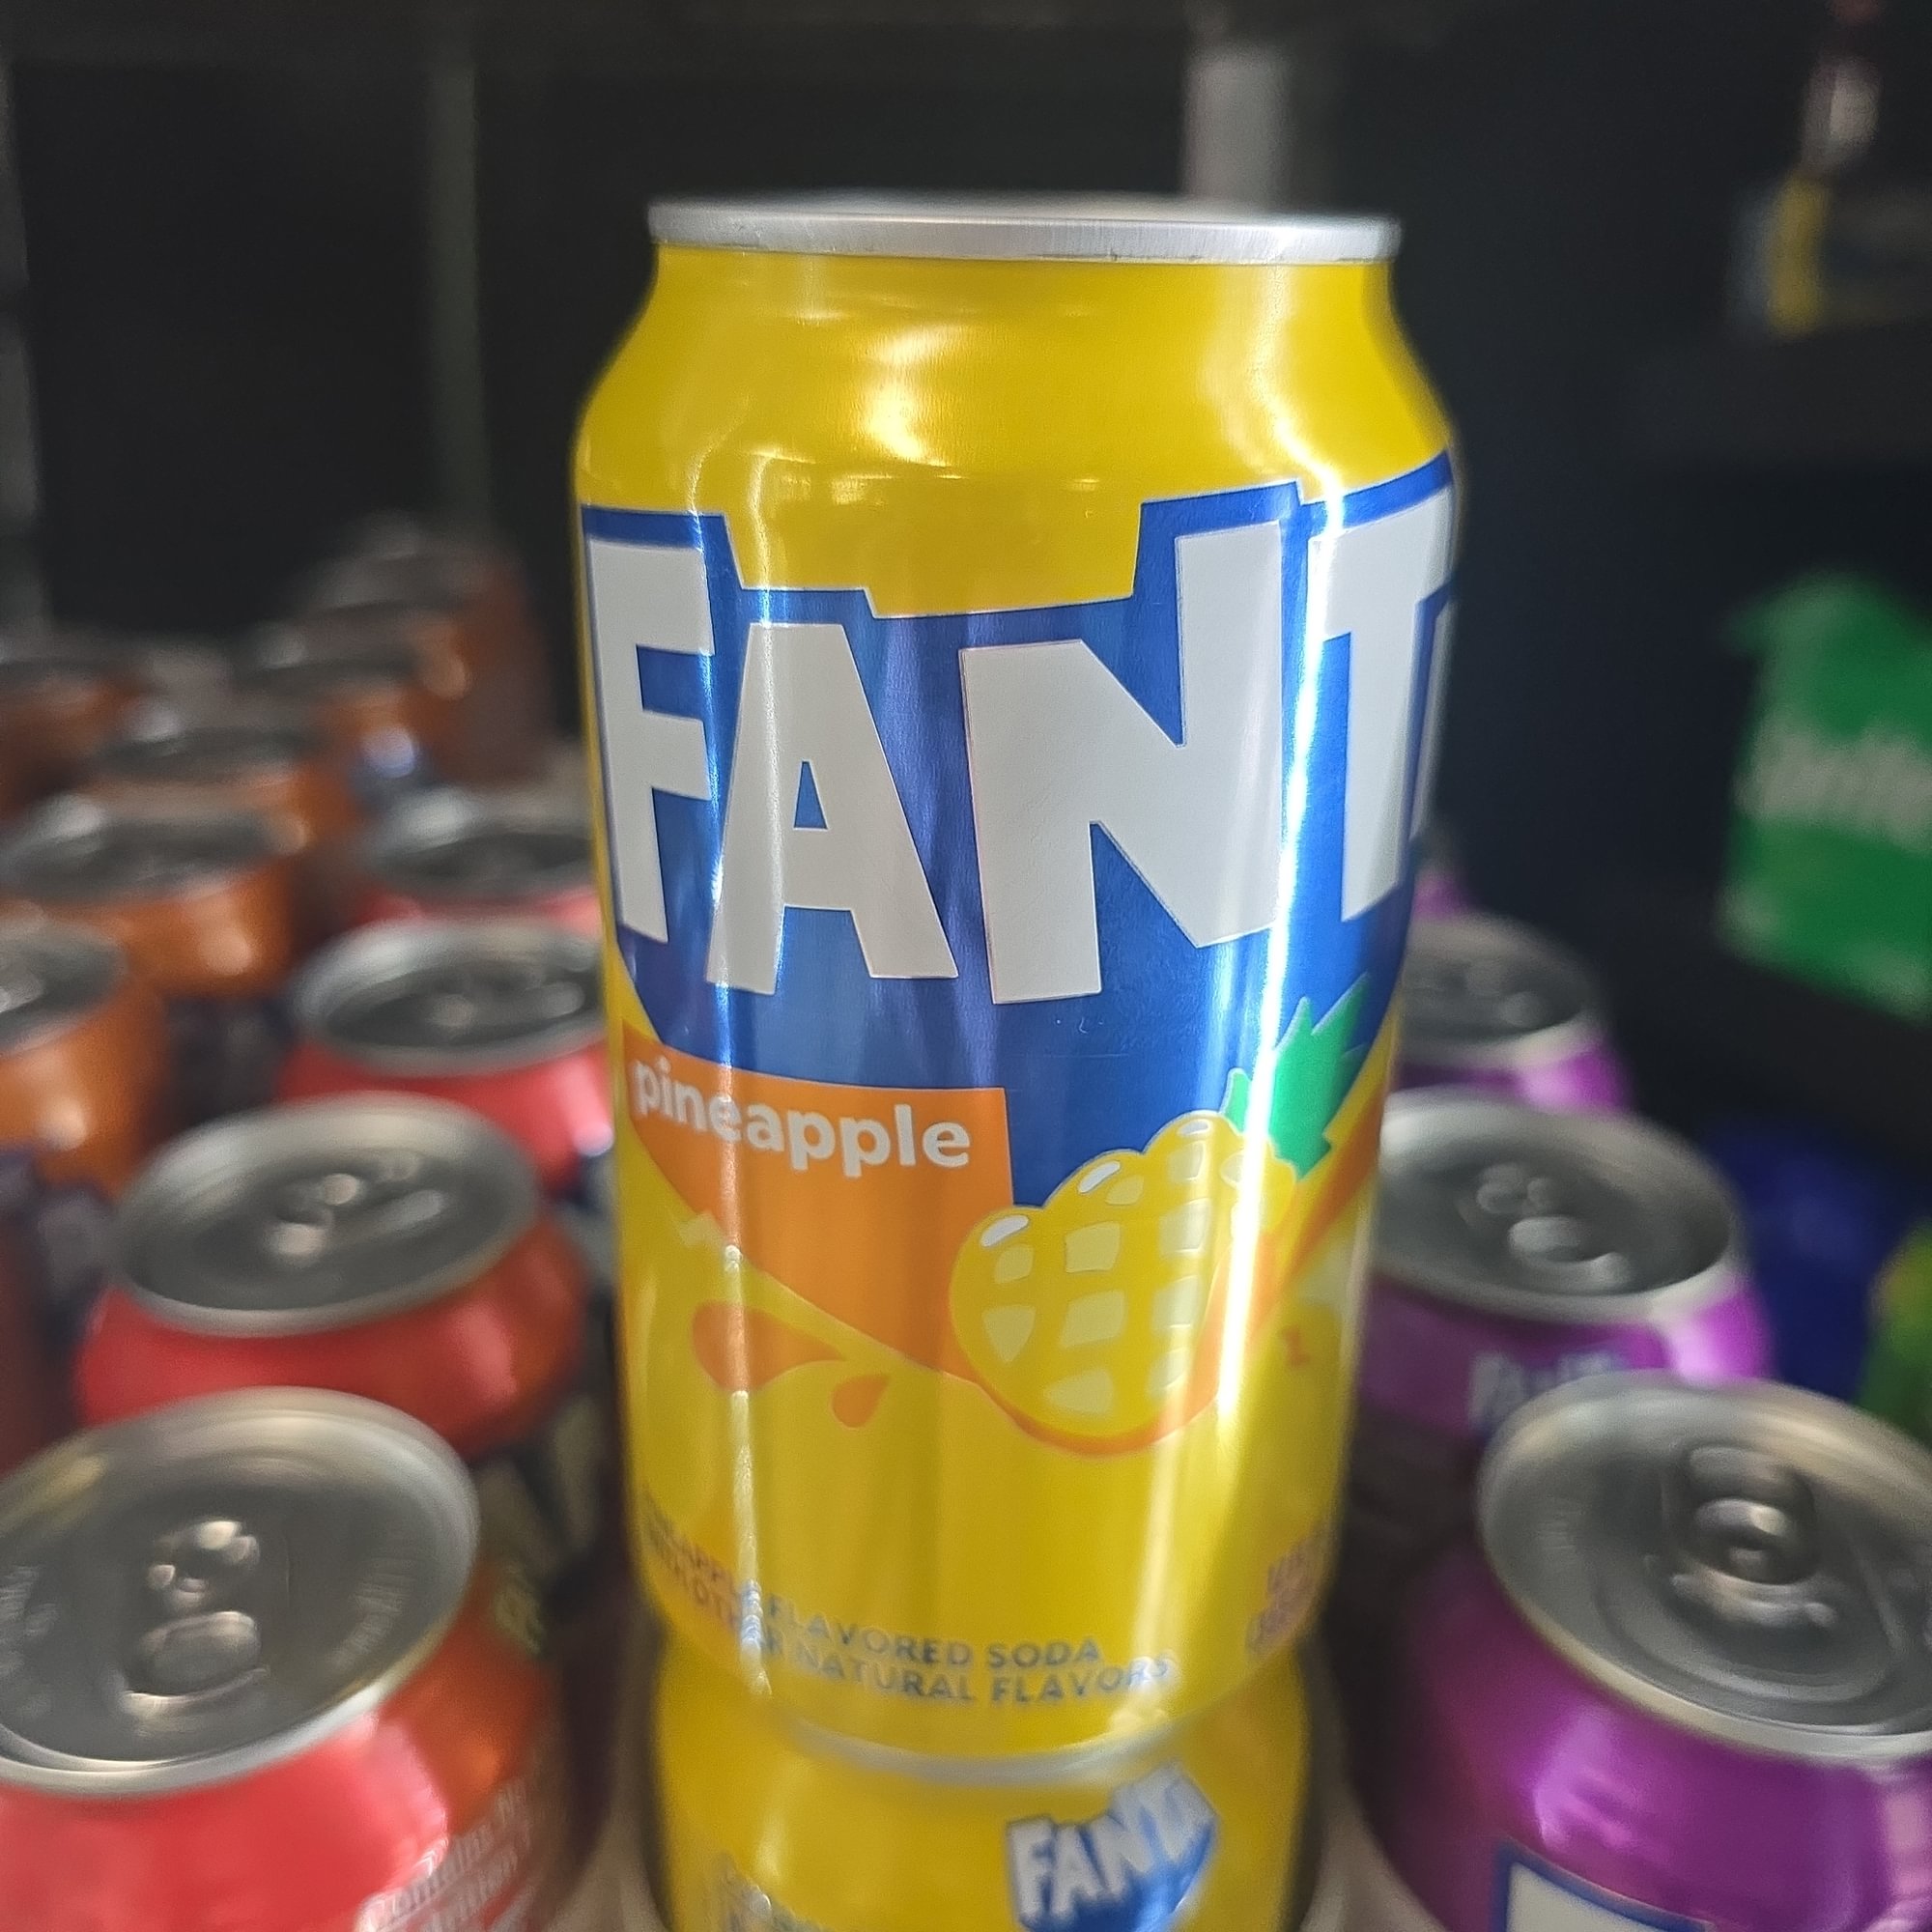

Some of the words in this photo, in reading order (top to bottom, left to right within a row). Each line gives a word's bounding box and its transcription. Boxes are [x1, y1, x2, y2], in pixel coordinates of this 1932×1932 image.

[587, 485, 1455, 1005] FANT
[634, 1057, 972, 1179] pineapple
[767, 1594, 973, 1668] FLAVORED
[987, 1636, 1100, 1669] SODA
[794, 1640, 975, 1703] NATURAL
